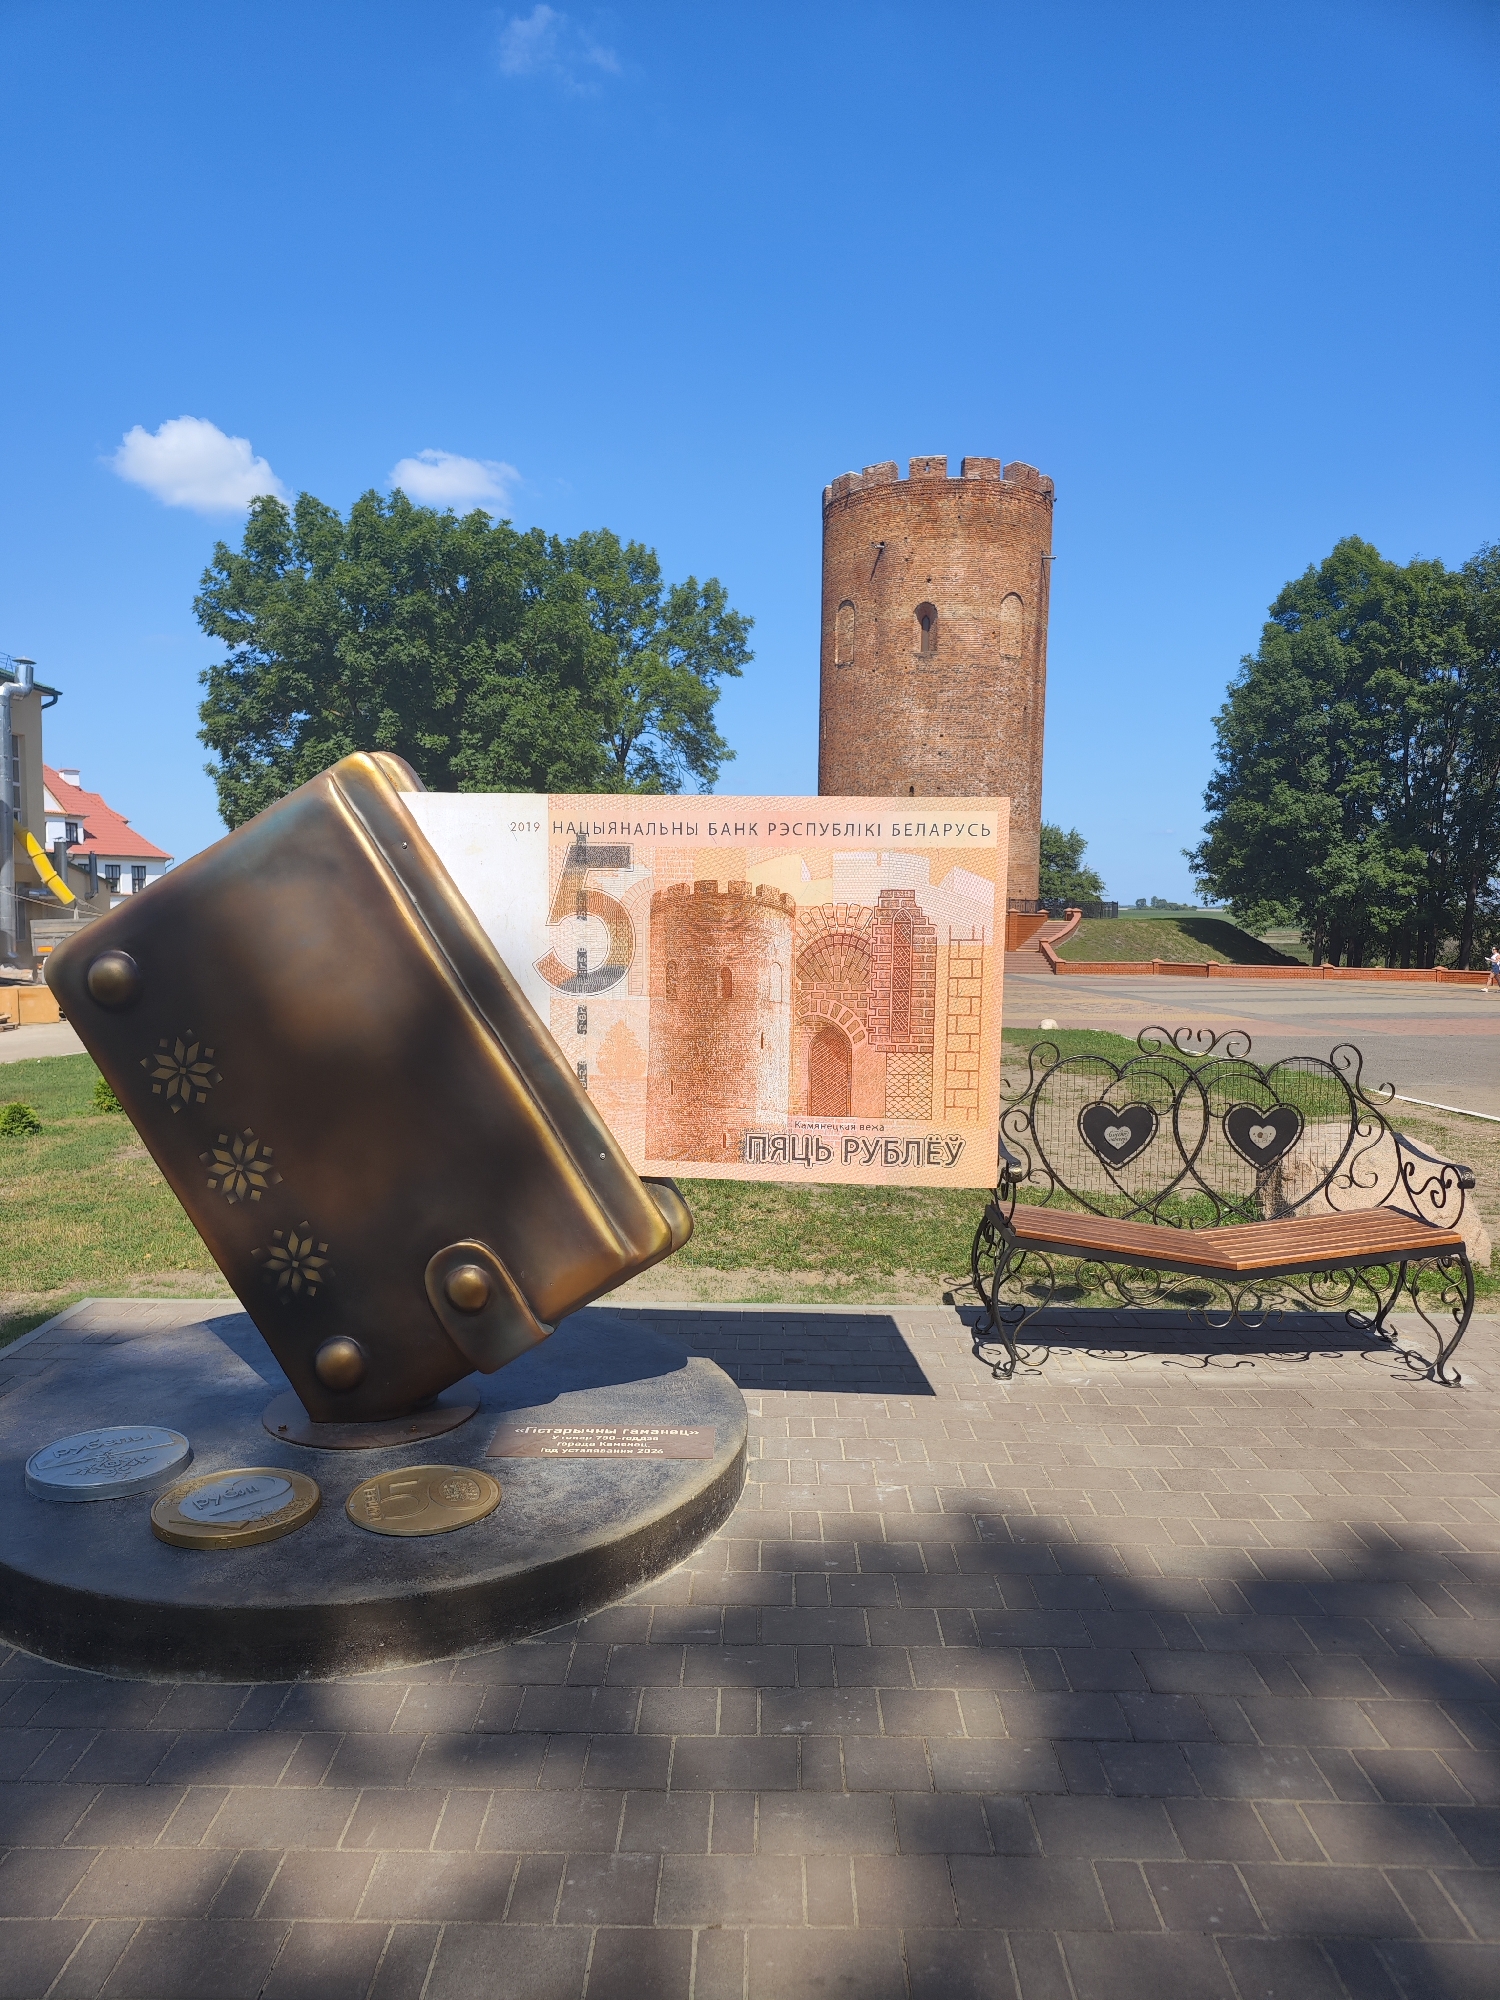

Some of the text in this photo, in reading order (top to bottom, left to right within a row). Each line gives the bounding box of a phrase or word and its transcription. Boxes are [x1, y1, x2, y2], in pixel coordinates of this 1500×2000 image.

[509, 821, 541, 832] 2019
[552, 820, 991, 838] НАЦЫЯНАЛЬНЫ БАНК РЭСПУБЛІКІ БЕЛАРУСЬ
[532, 842, 636, 997] 5
[794, 1120, 886, 1133] Камянецкая вежа
[746, 1133, 967, 1169] ПЯЦЬ РУБЛЁЎ
